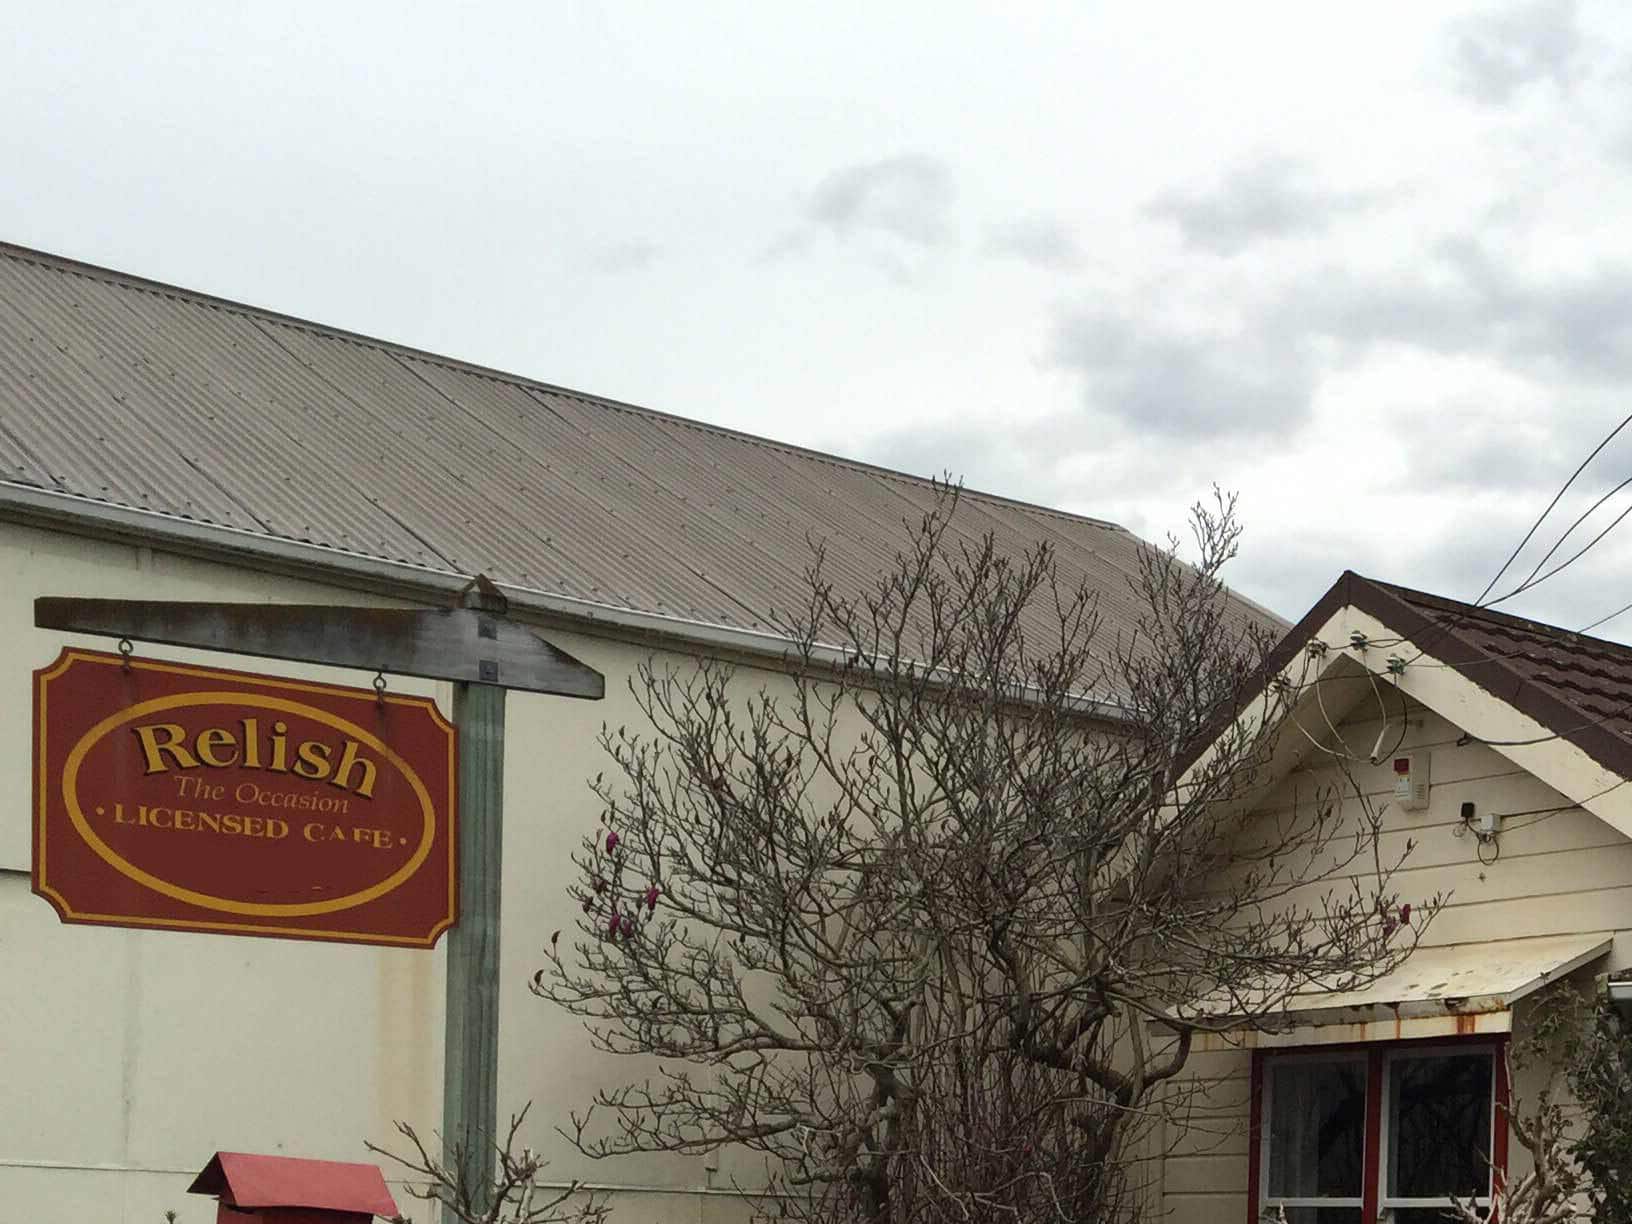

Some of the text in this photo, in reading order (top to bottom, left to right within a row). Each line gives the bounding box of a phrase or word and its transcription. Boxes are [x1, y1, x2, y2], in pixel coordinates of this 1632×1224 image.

[133, 717, 378, 798] Relish
[174, 775, 351, 814] The Occasion
[114, 803, 393, 849] LICENSED CAFE
